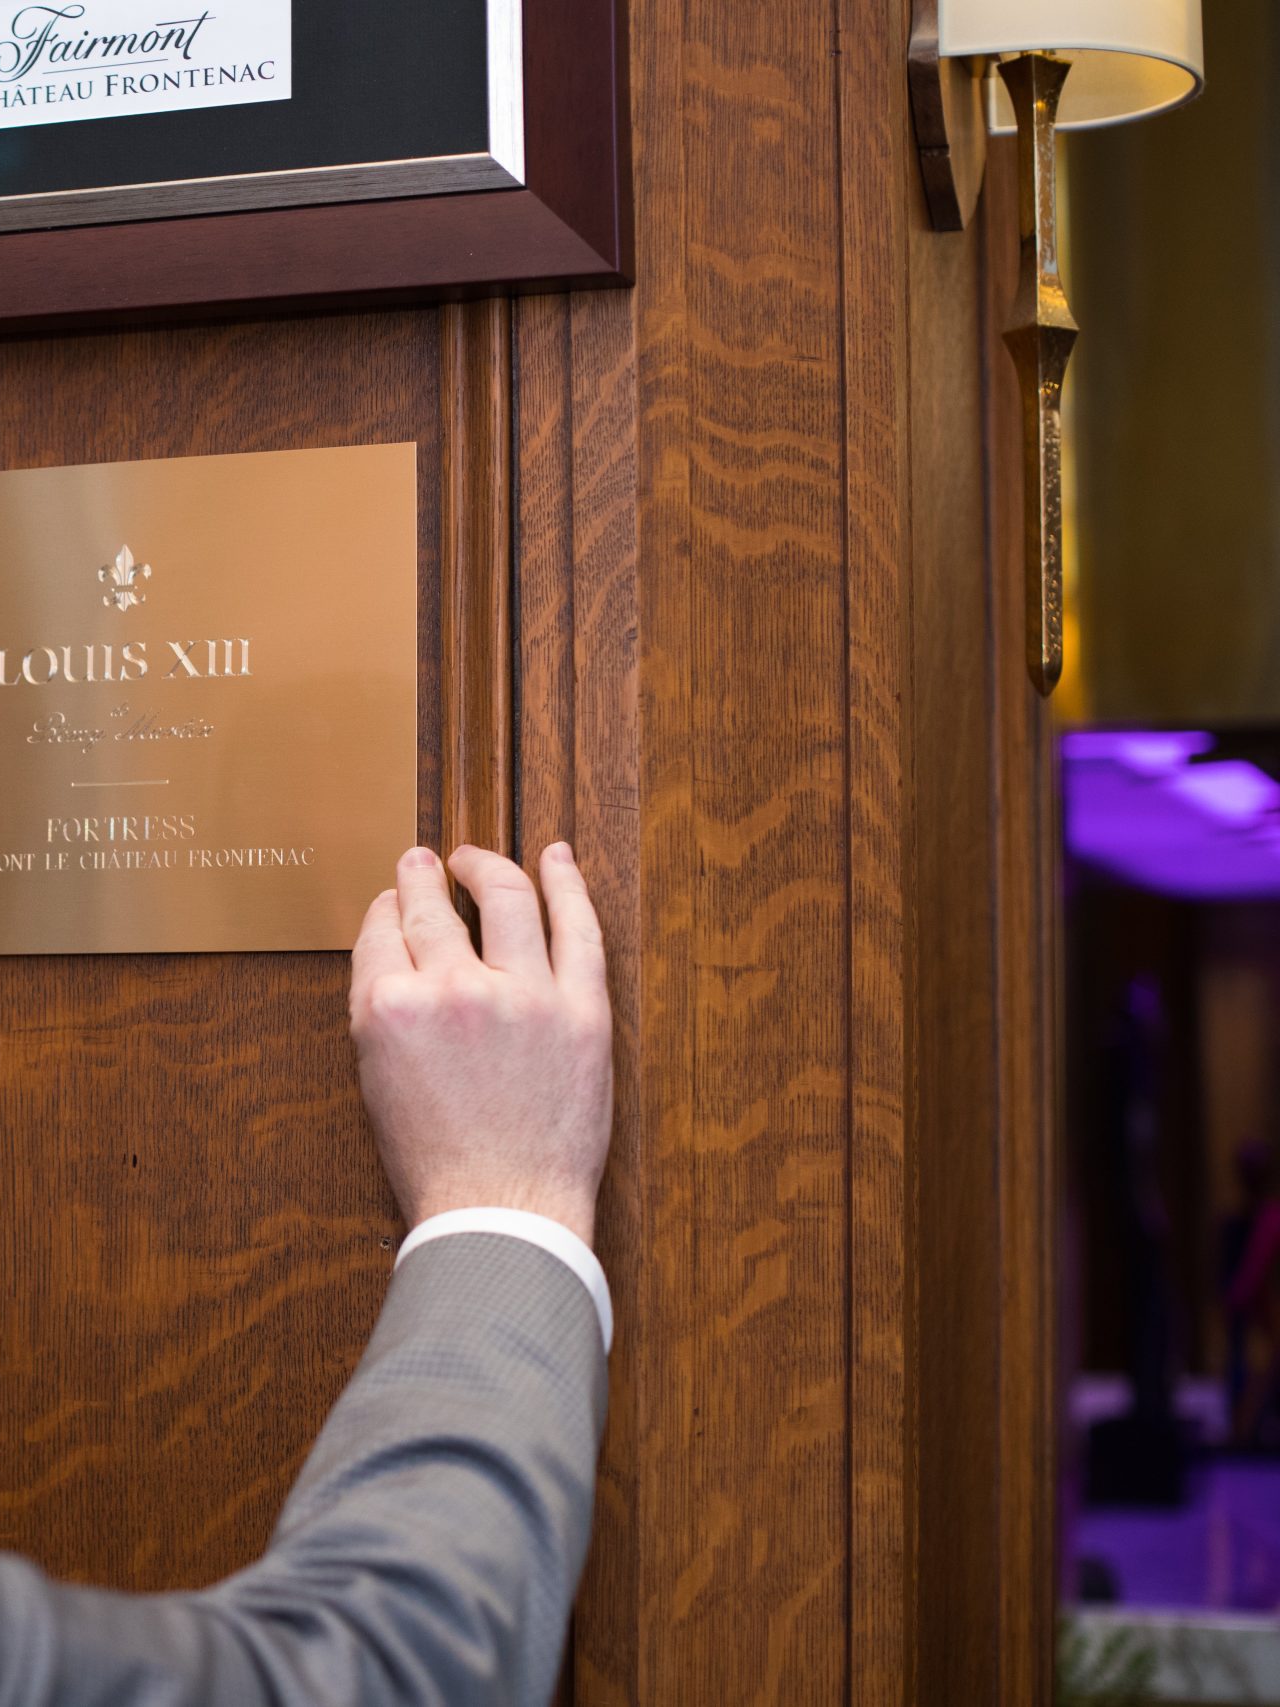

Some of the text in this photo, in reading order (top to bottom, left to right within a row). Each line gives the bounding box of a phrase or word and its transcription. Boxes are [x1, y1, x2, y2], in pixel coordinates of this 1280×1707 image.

[106, 61, 275, 97] FRONTENAC
[161, 638, 253, 680] XIII
[47, 815, 196, 843] FORTRESS
[45, 852, 70, 871] LE
[188, 847, 315, 868] FRONTENAC
